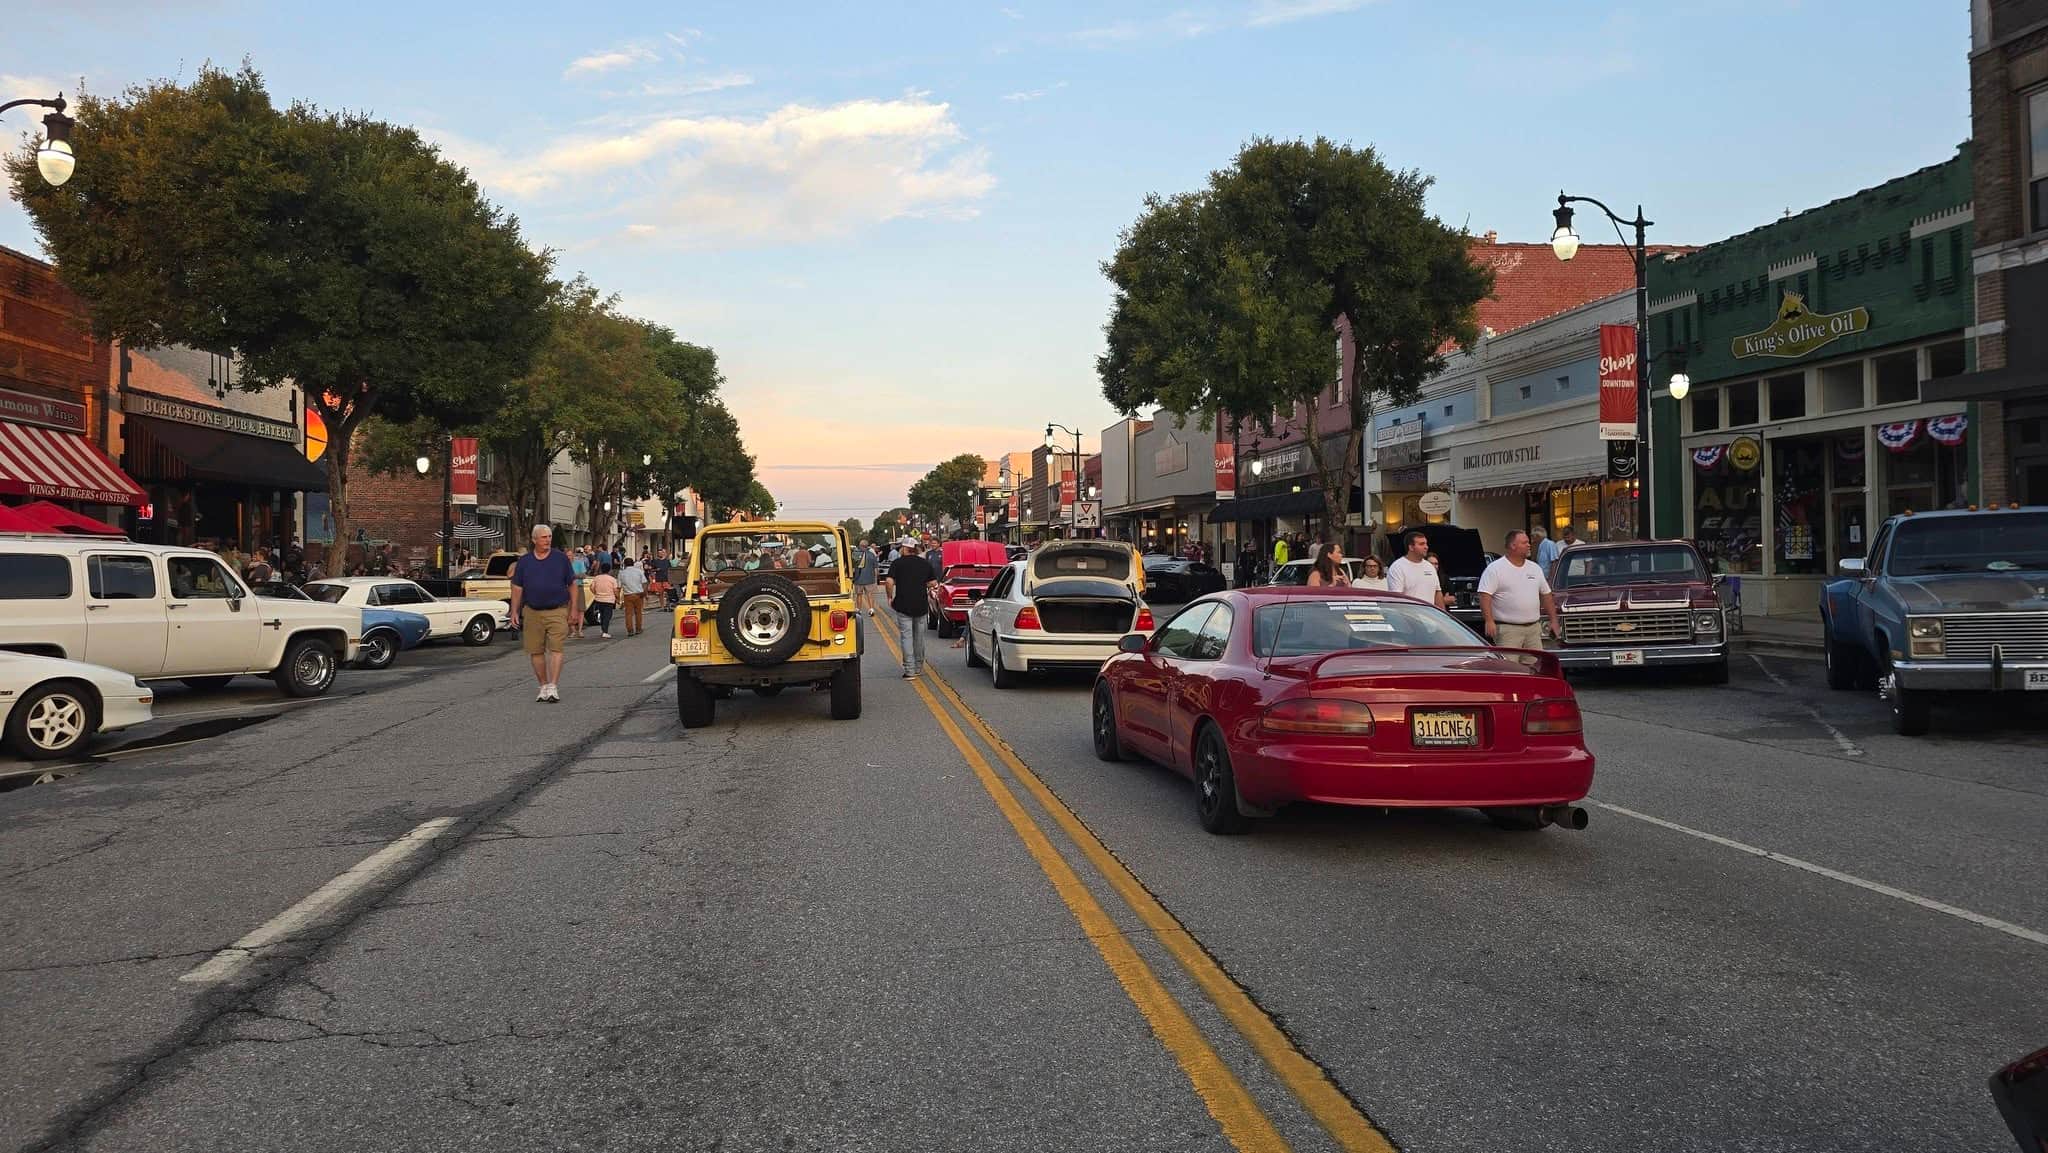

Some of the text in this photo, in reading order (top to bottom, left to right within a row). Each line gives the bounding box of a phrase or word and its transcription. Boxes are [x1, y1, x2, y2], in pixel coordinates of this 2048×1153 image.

[1745, 313, 1855, 353] King's Olive Oil
[1599, 353, 1638, 376] Shop
[1603, 379, 1634, 388] DOWNTOWN
[42, 402, 80, 424] Wings
[224, 414, 247, 431] PUB
[257, 422, 292, 440] EATERY
[452, 454, 477, 468] Shop
[1463, 445, 1541, 470] HIGH COTTON STYLE
[28, 483, 130, 503] WINGS BURGERS OYSTERS
[1417, 720, 1473, 737] 31ACNE6
